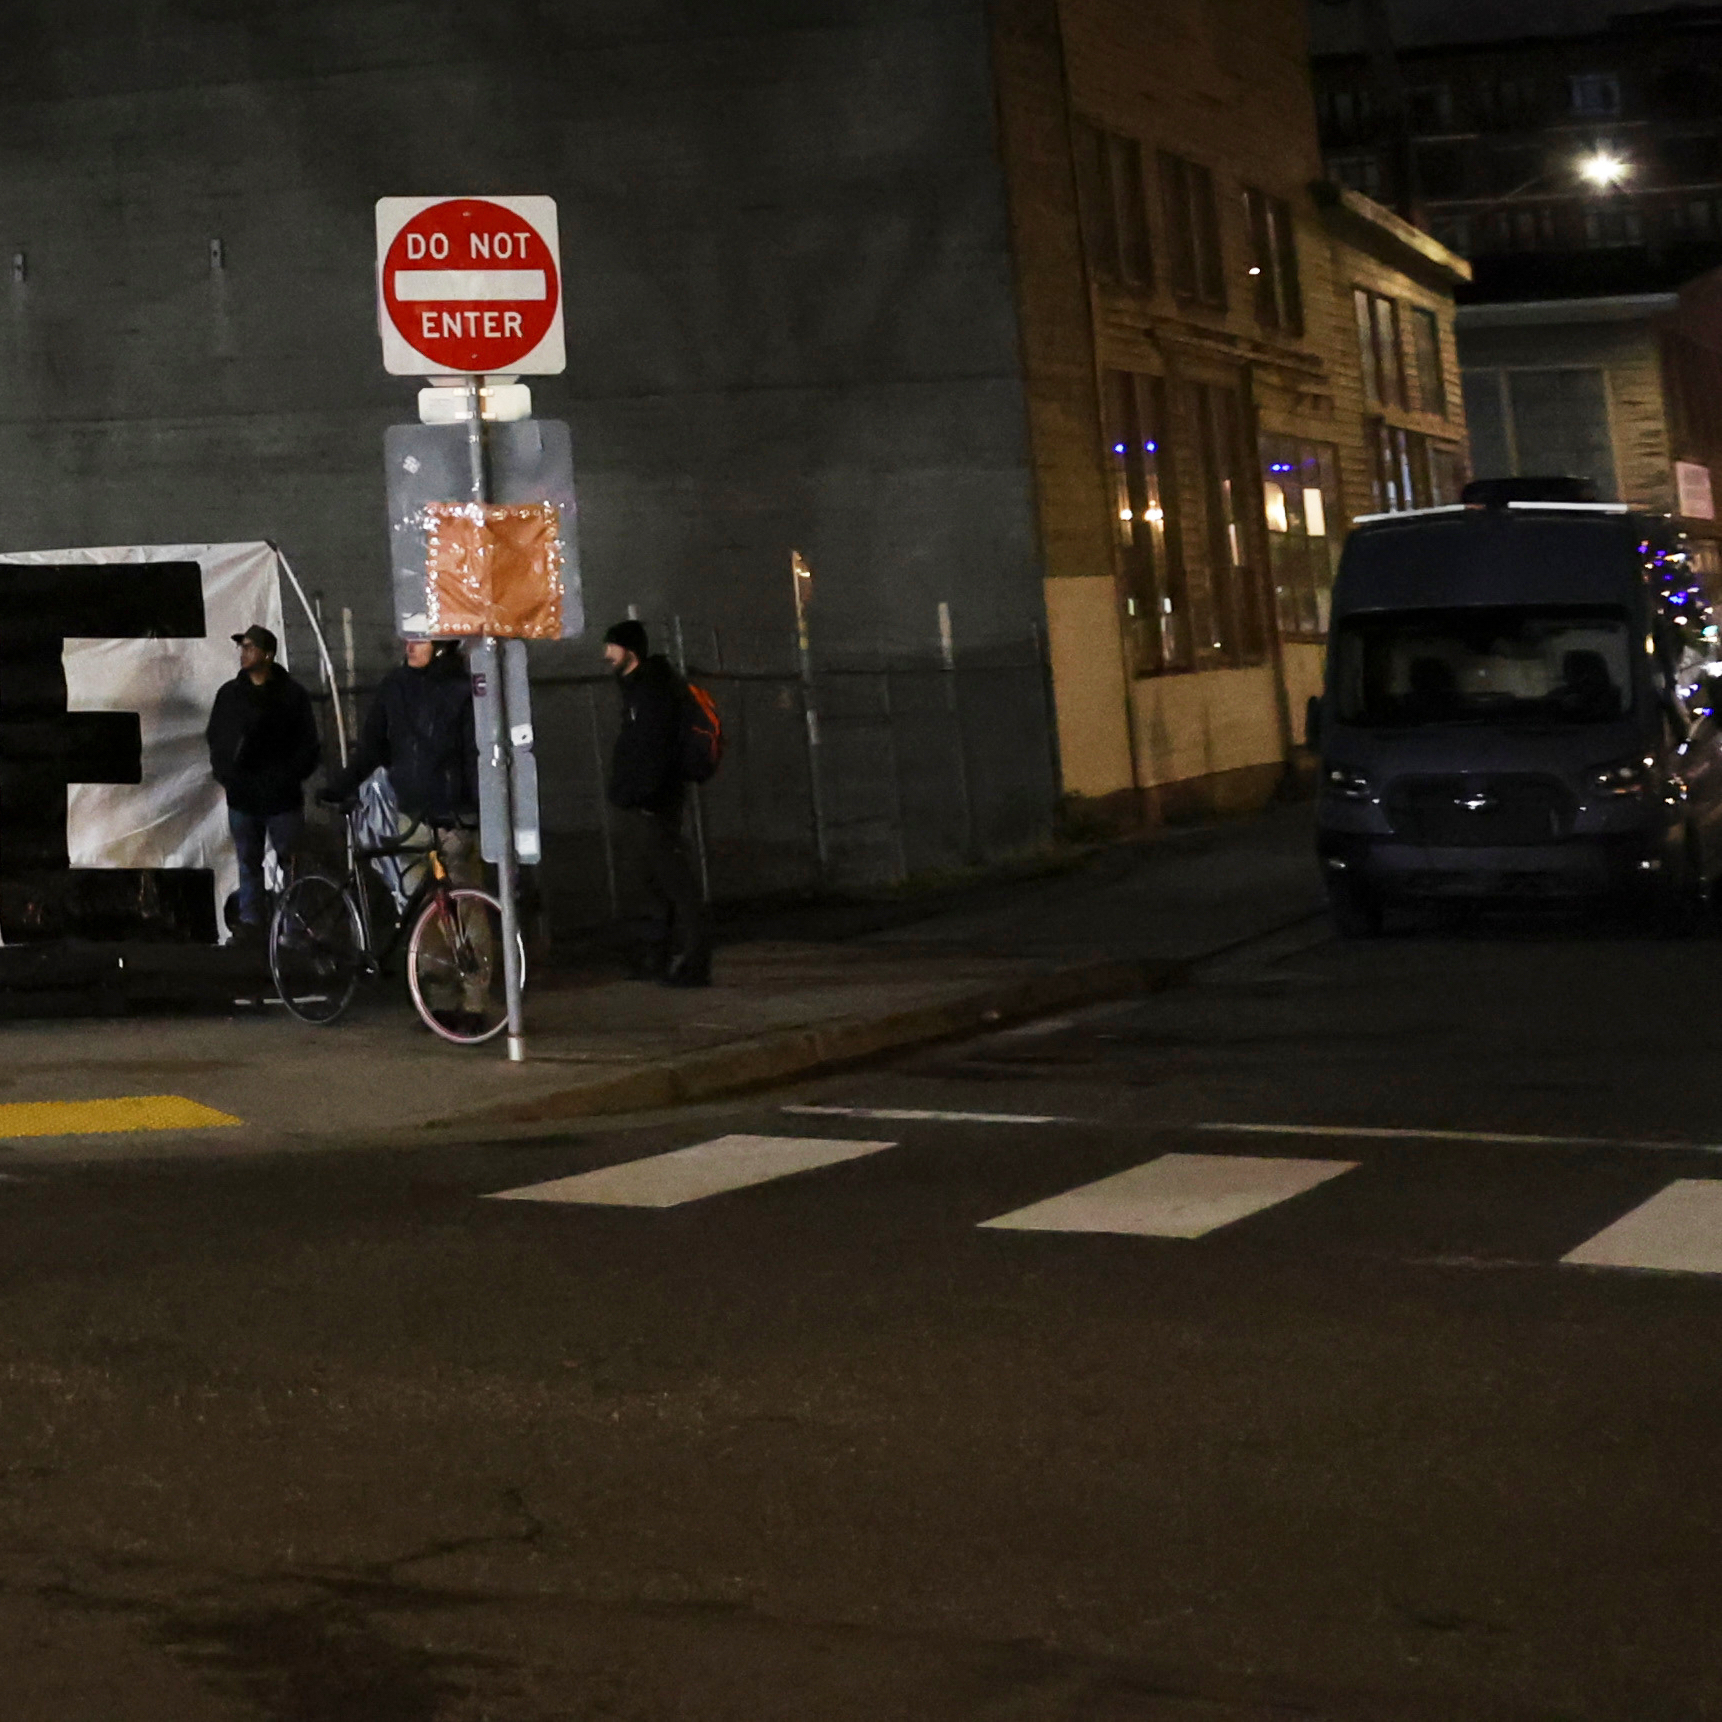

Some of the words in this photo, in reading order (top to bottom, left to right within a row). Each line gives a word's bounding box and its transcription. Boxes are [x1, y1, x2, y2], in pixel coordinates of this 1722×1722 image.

[406, 233, 449, 260] DO
[469, 232, 531, 260] NOT
[422, 311, 523, 339] ENTER
